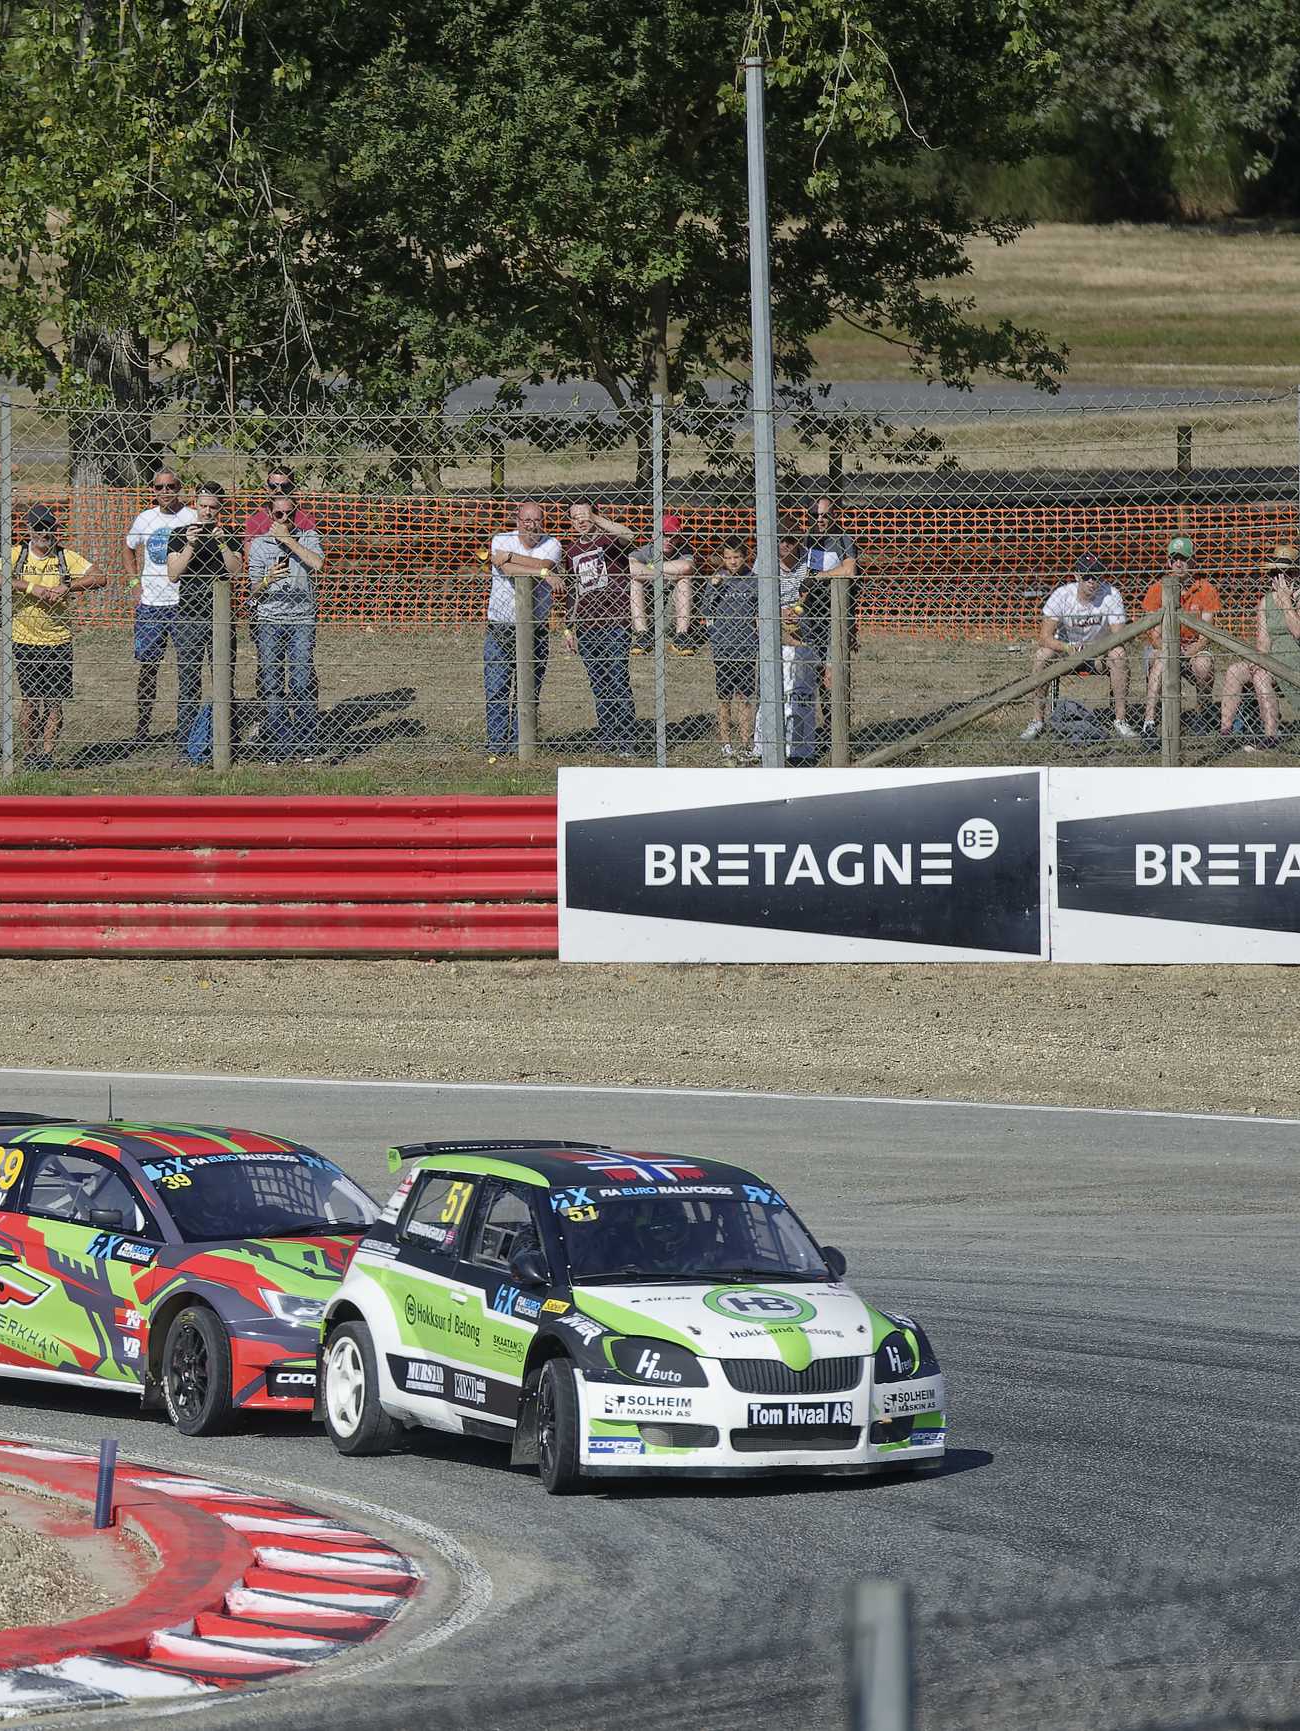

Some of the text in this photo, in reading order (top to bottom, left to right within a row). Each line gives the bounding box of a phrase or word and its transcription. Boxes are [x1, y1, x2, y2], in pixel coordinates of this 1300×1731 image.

[963, 829, 993, 848] BE
[645, 843, 952, 886] BRETAGNE
[188, 1156, 210, 1166] FIA
[209, 1155, 238, 1164] EURO
[238, 1153, 300, 1163] RALLYCROSS
[161, 1173, 193, 1190] 39
[600, 1188, 622, 1198] FIA
[623, 1187, 657, 1197] EURO
[658, 1185, 733, 1196] RALLYCROSS
[441, 1181, 474, 1225] 51
[567, 1206, 598, 1223] 51
[727, 1297, 796, 1313] HB
[454, 1315, 481, 1347] Betong
[729, 1324, 795, 1340] Hokksund
[6, 1338, 28, 1353] TEAM
[636, 1349, 682, 1383] Hi auto
[276, 1373, 316, 1386] COO
[627, 1395, 692, 1408] SOLHEIM
[898, 1388, 936, 1404] SOLHEIM
[626, 1408, 692, 1418] MASKIN AS
[750, 1402, 852, 1425] Tom Hvaal AS
[927, 1401, 937, 1410] AS
[588, 1440, 641, 1450] COOPER
